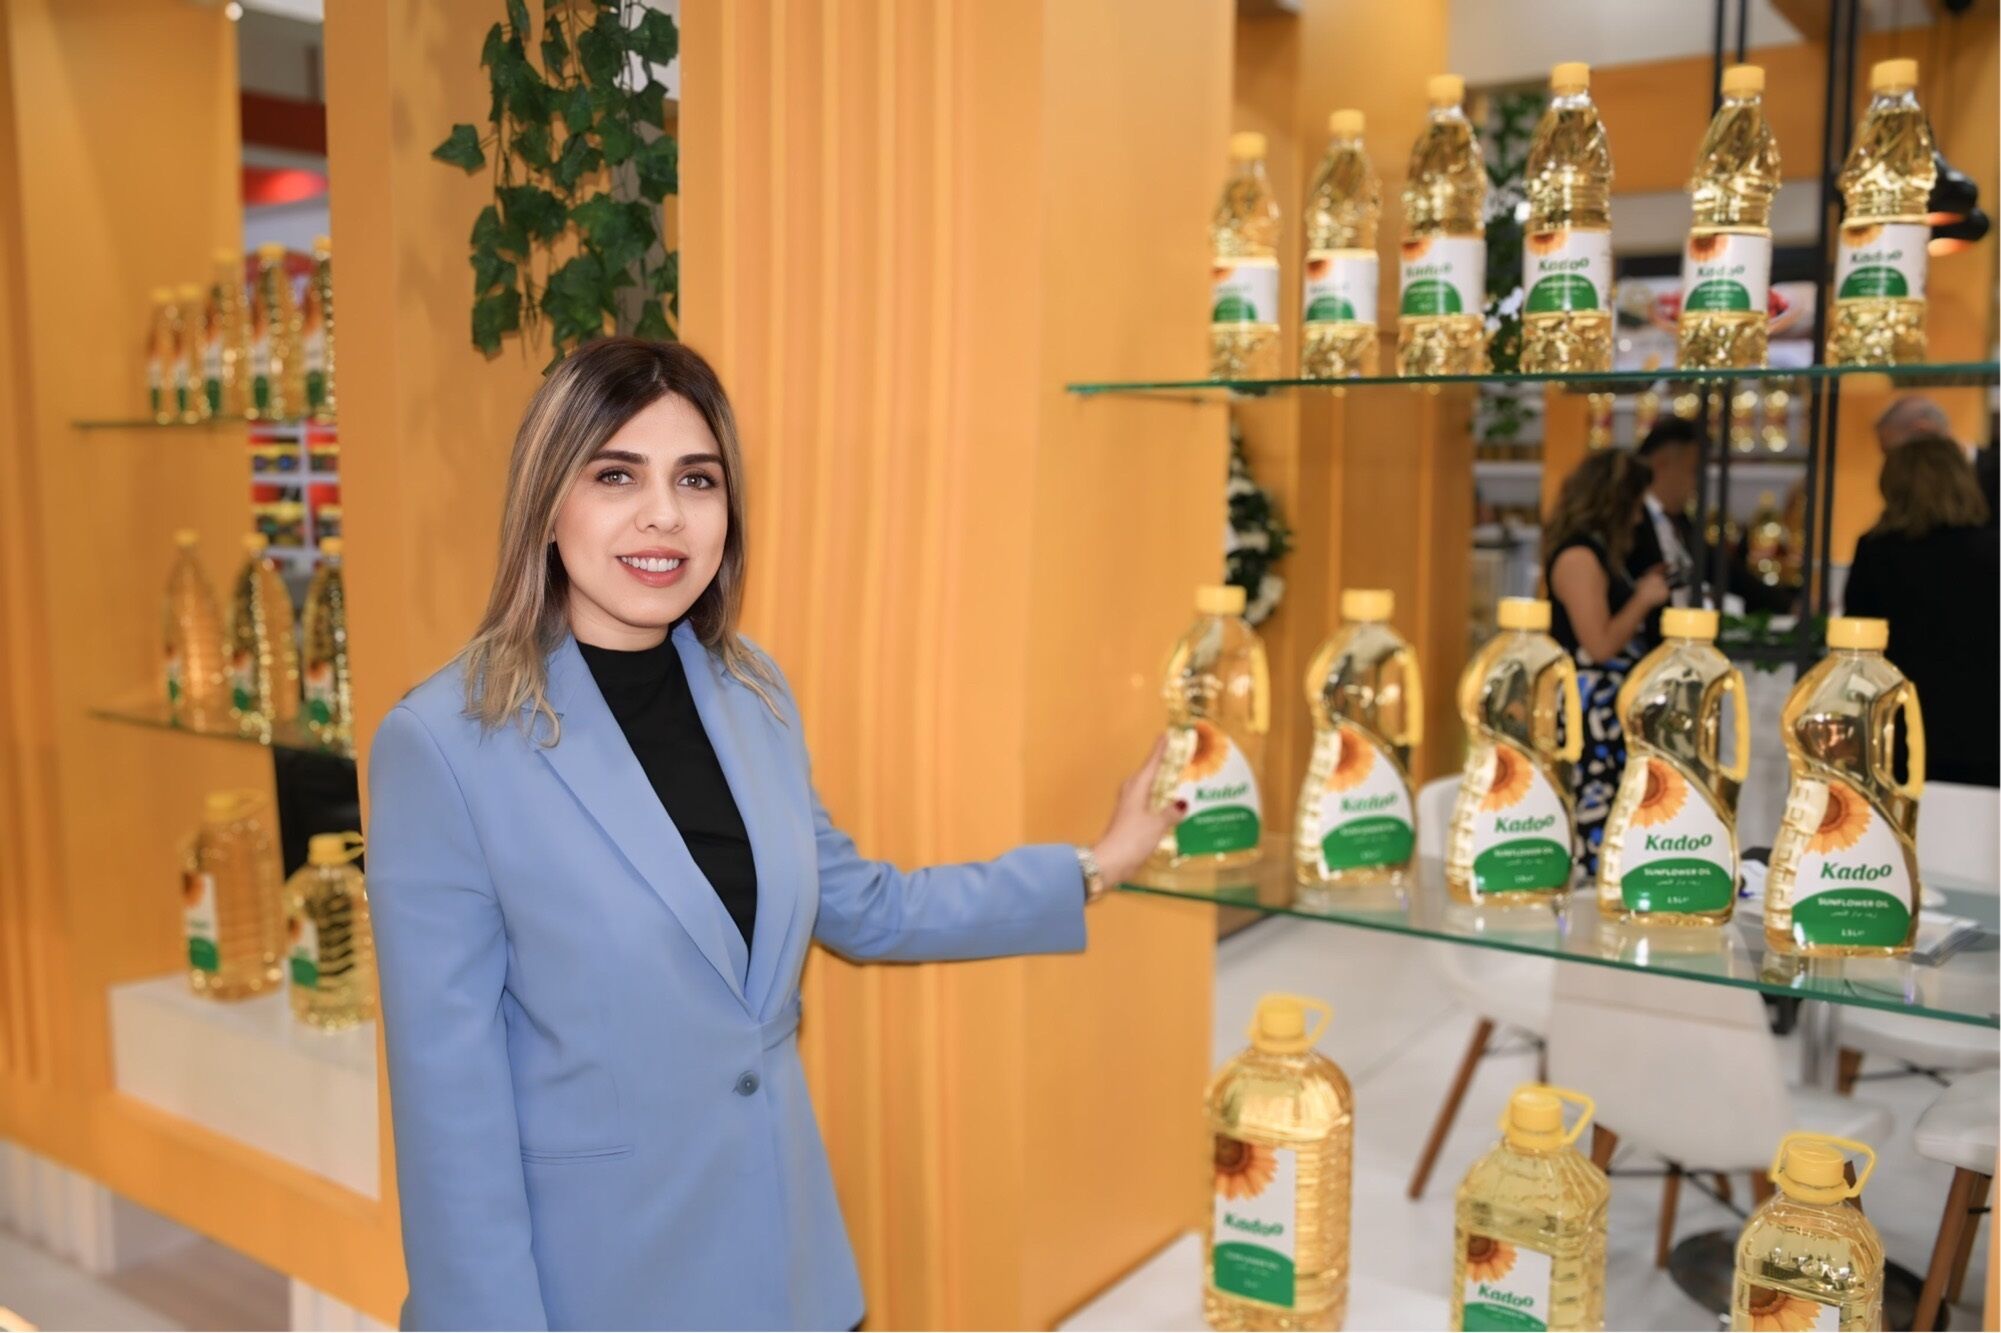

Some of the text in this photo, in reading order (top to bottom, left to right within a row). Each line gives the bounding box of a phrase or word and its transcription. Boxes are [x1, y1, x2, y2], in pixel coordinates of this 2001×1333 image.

[1494, 814, 1555, 833] Kadoo
[1644, 833, 1713, 851] Kadoo
[1643, 867, 1697, 877] SUNFLOWER
[1820, 861, 1893, 881] Kadoo
[1817, 897, 1874, 908] SUNFLOWER
[1478, 1284, 1535, 1307] Kadoo
